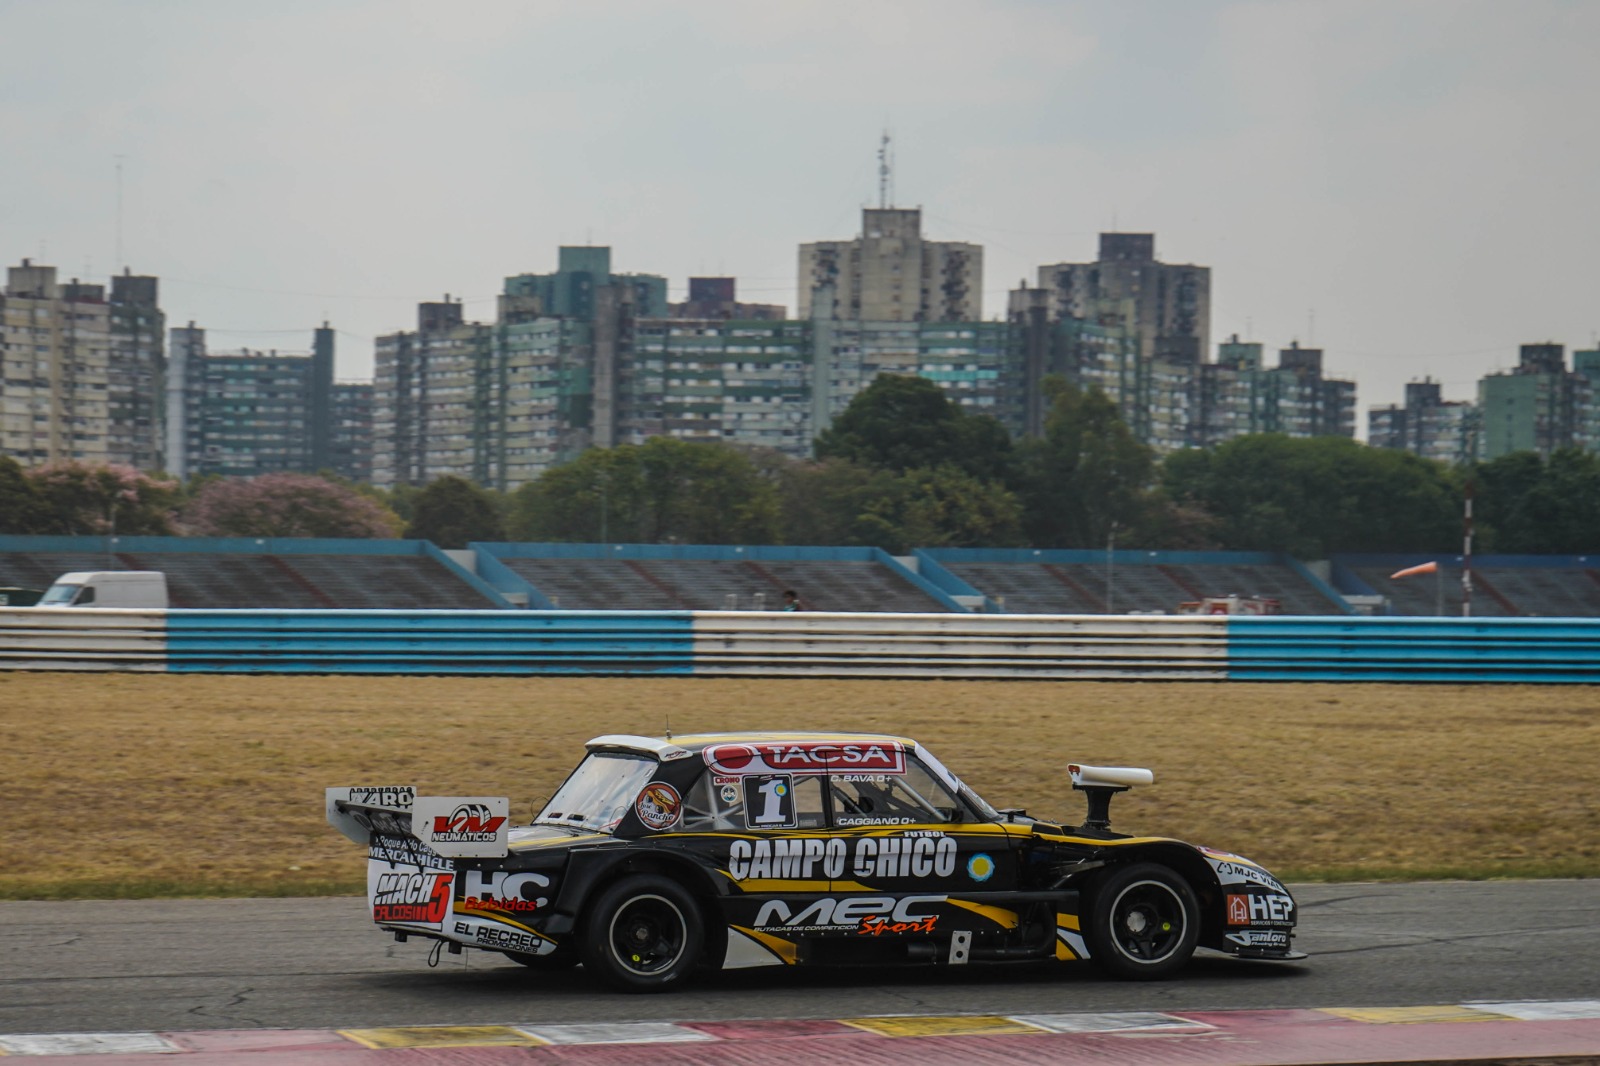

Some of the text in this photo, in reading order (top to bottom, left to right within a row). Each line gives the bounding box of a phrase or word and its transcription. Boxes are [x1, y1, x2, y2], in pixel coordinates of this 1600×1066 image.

[767, 745, 892, 764] TACSA
[844, 775, 875, 783] BAVA
[755, 780, 786, 823] 1
[838, 817, 899, 826] CAGGIANO
[431, 832, 496, 842] NEUMATICOS
[729, 837, 957, 881] CAMPO CHICO
[1234, 867, 1258, 879] MJC
[464, 870, 550, 908] HC
[464, 896, 537, 911] Bebidas
[454, 922, 543, 948] EL RECREO
[857, 915, 938, 937] Sport
[476, 937, 538, 954] PROMOCIONES
